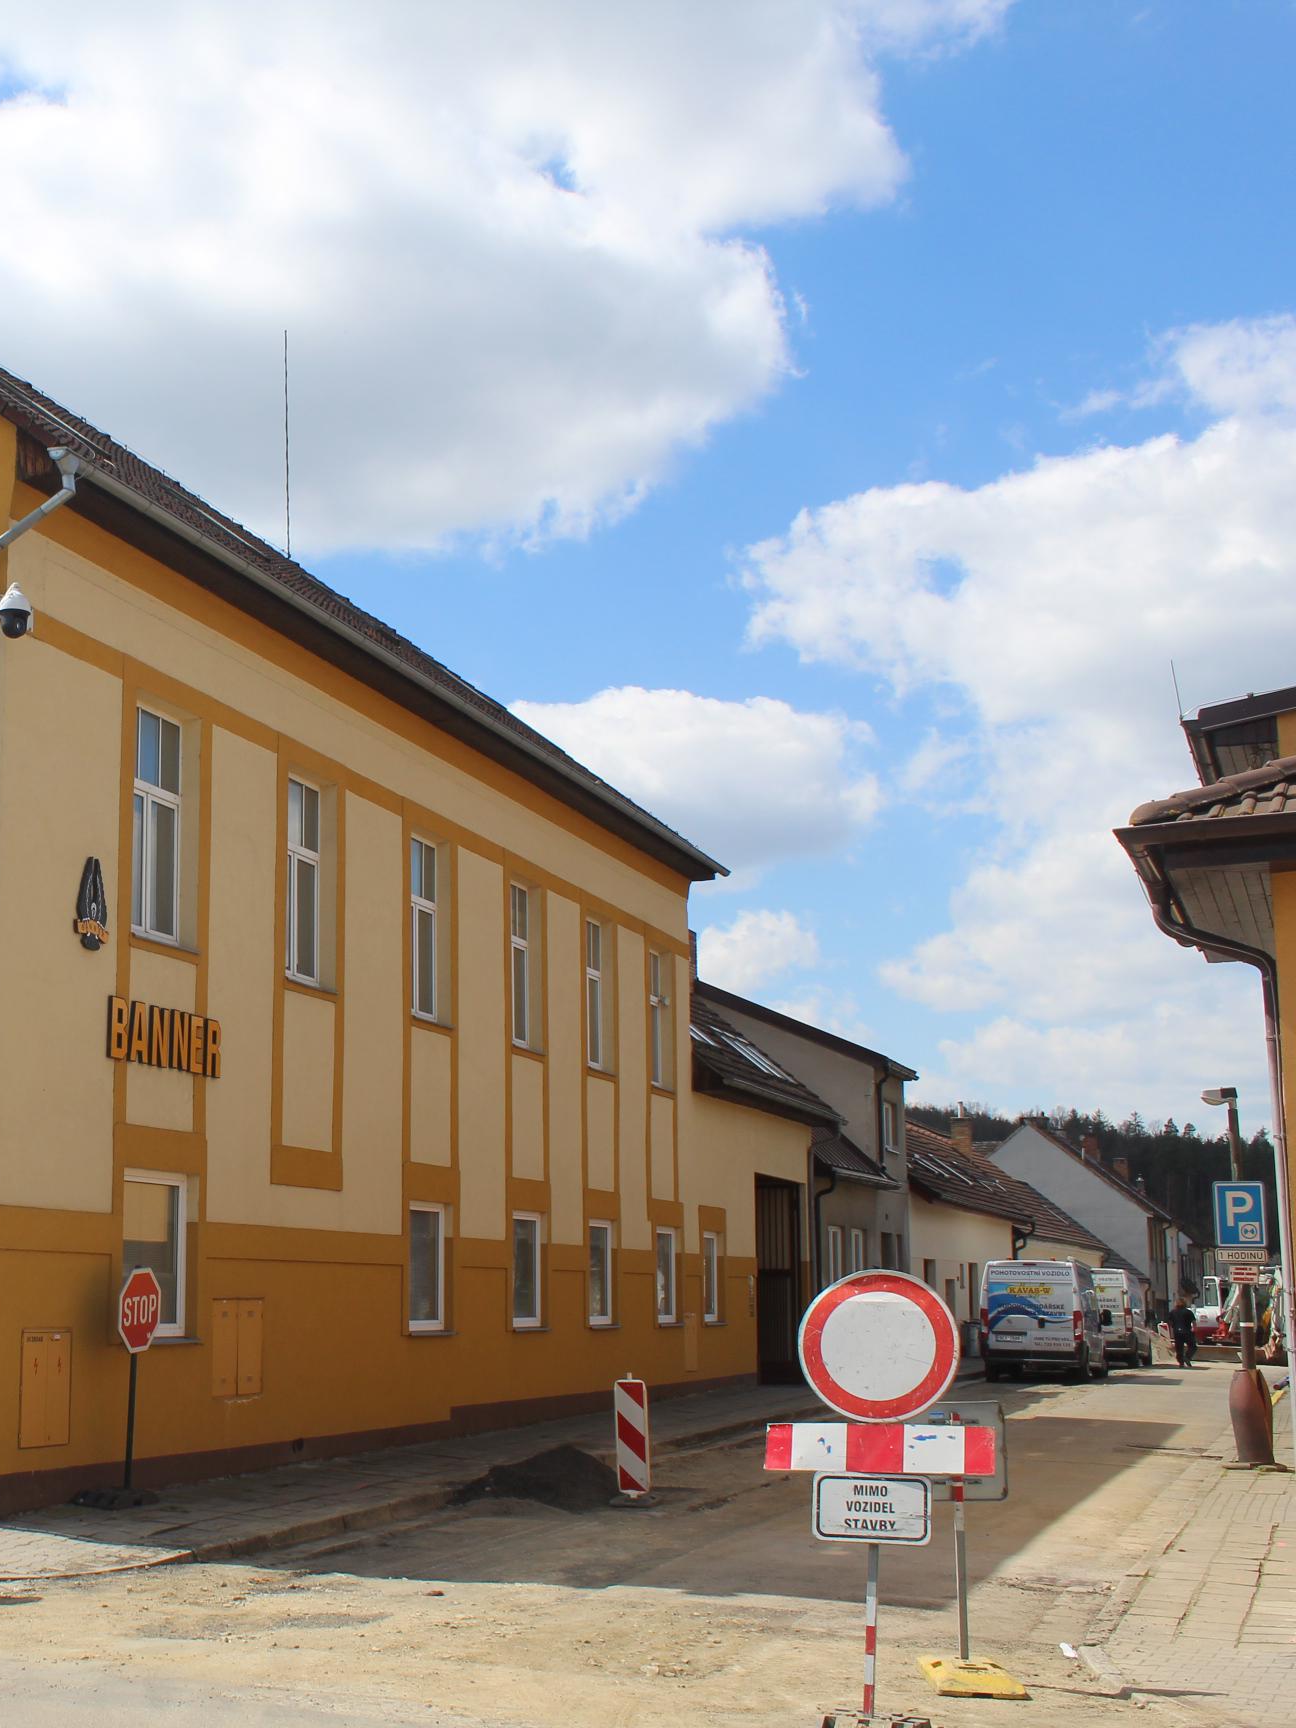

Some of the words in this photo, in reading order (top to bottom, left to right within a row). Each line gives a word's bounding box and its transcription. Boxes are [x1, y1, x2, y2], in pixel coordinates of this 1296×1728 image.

[106, 995, 222, 1078] BANNER
[1225, 1191, 1253, 1227] P
[1219, 1252, 1223, 1260] 1
[1227, 1252, 1263, 1260] HODINU
[123, 1294, 157, 1327] STOP
[853, 1485, 888, 1497] MIMO
[846, 1500, 895, 1513] VOZIDEL
[844, 1518, 896, 1531] STAVBY
